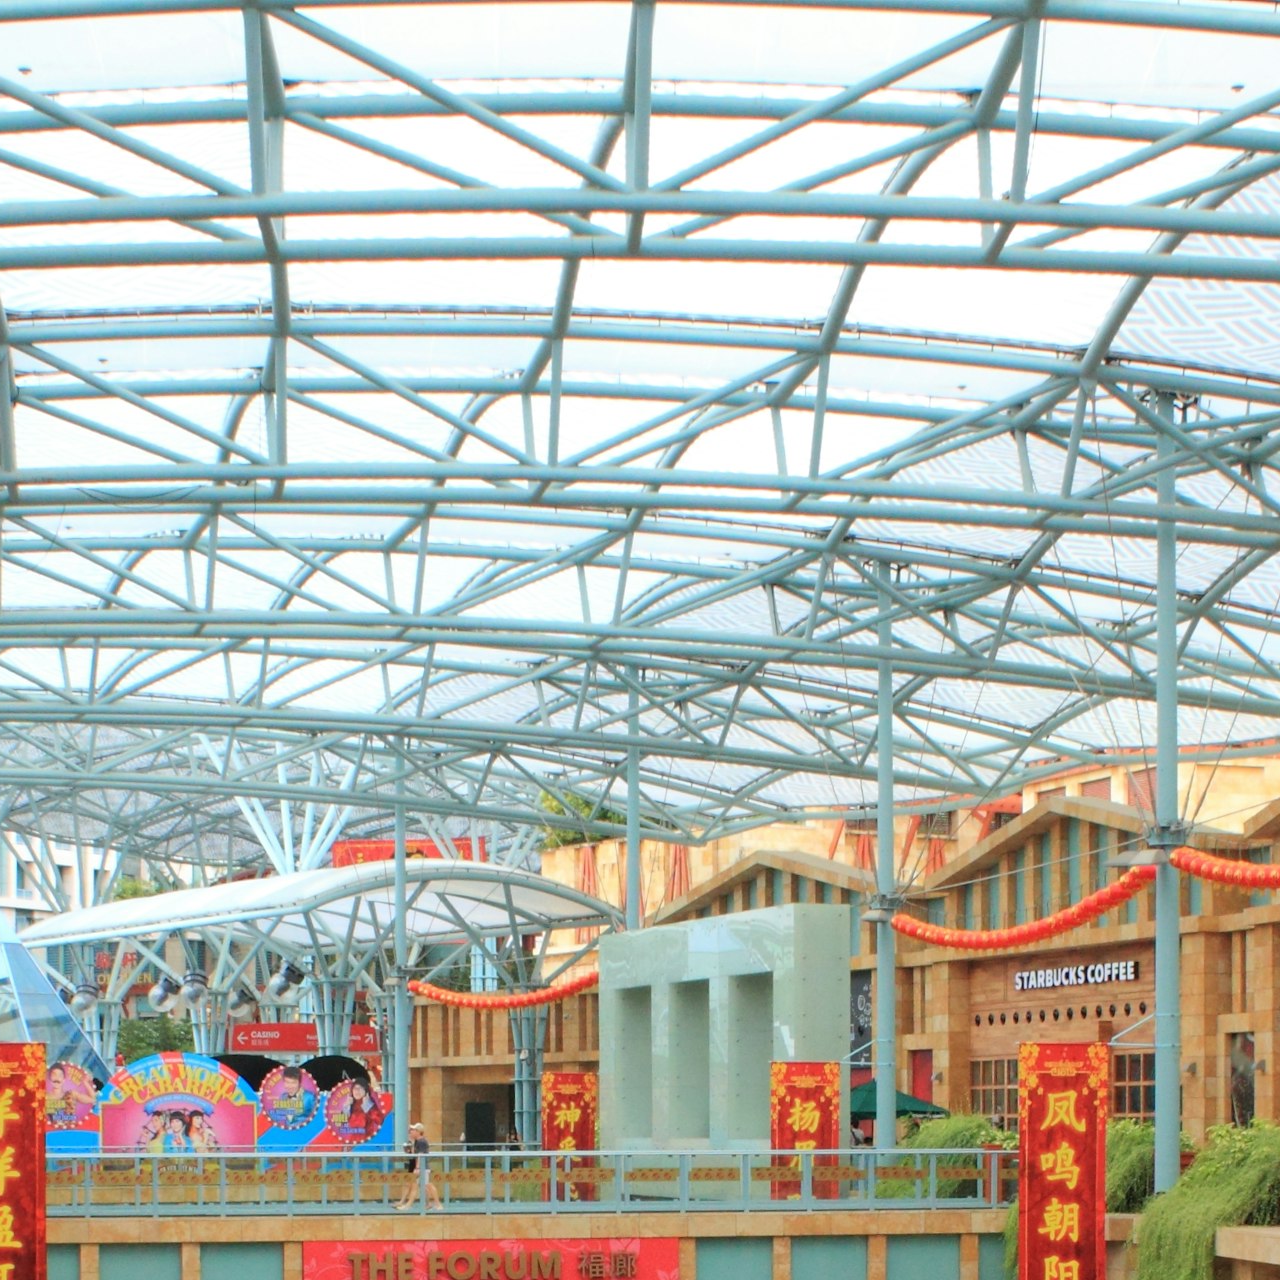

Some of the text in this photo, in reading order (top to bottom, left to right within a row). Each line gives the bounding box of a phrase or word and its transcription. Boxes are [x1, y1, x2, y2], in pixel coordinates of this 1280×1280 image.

[1014, 960, 1135, 991] STARBUCKS COFFEE
[251, 1031, 280, 1040] CASINO
[110, 1064, 173, 1105] GREAT
[178, 1063, 247, 1107] WORLD
[133, 1077, 220, 1104] CABARET
